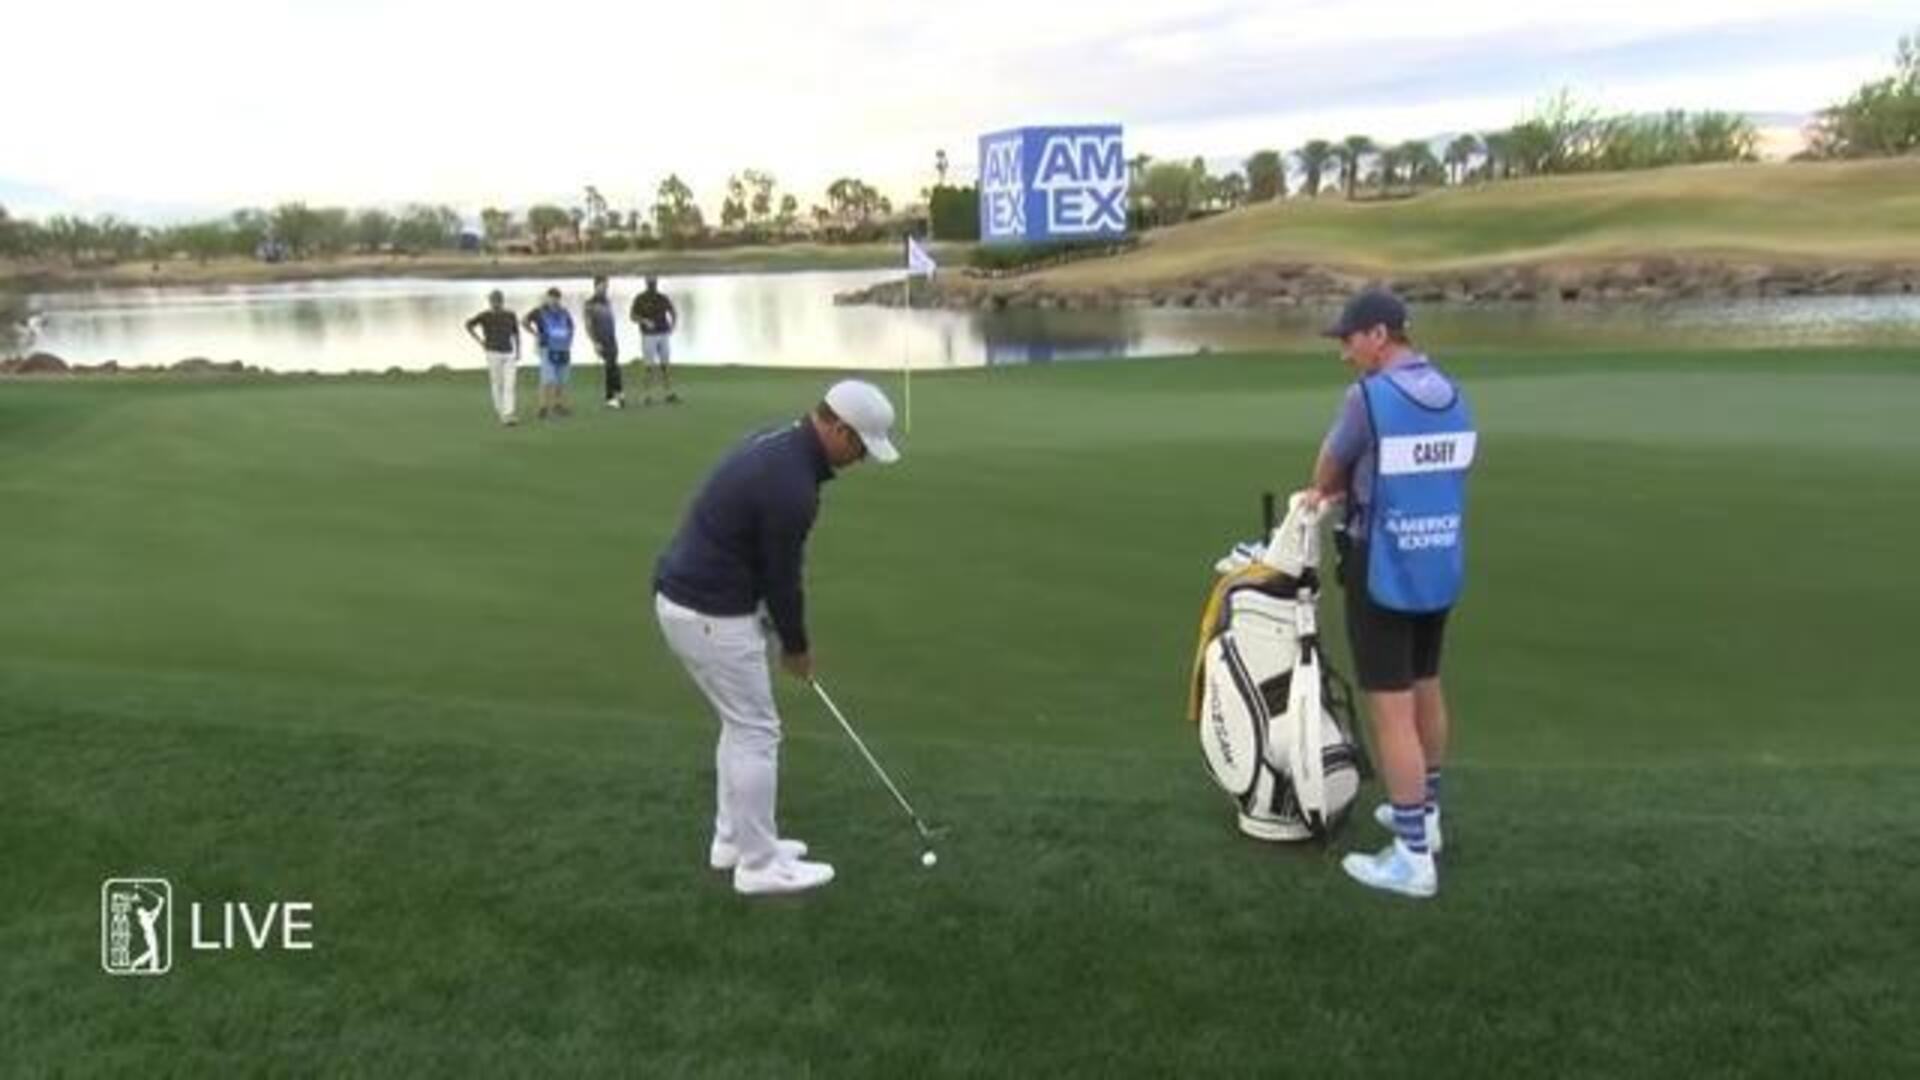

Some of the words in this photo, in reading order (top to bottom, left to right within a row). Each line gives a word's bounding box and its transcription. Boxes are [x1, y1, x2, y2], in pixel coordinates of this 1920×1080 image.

[985, 140, 1023, 187] AM
[1033, 136, 1127, 188] AM
[990, 190, 1026, 234] EX
[1048, 187, 1125, 232] EX
[1413, 441, 1456, 465] CASEY
